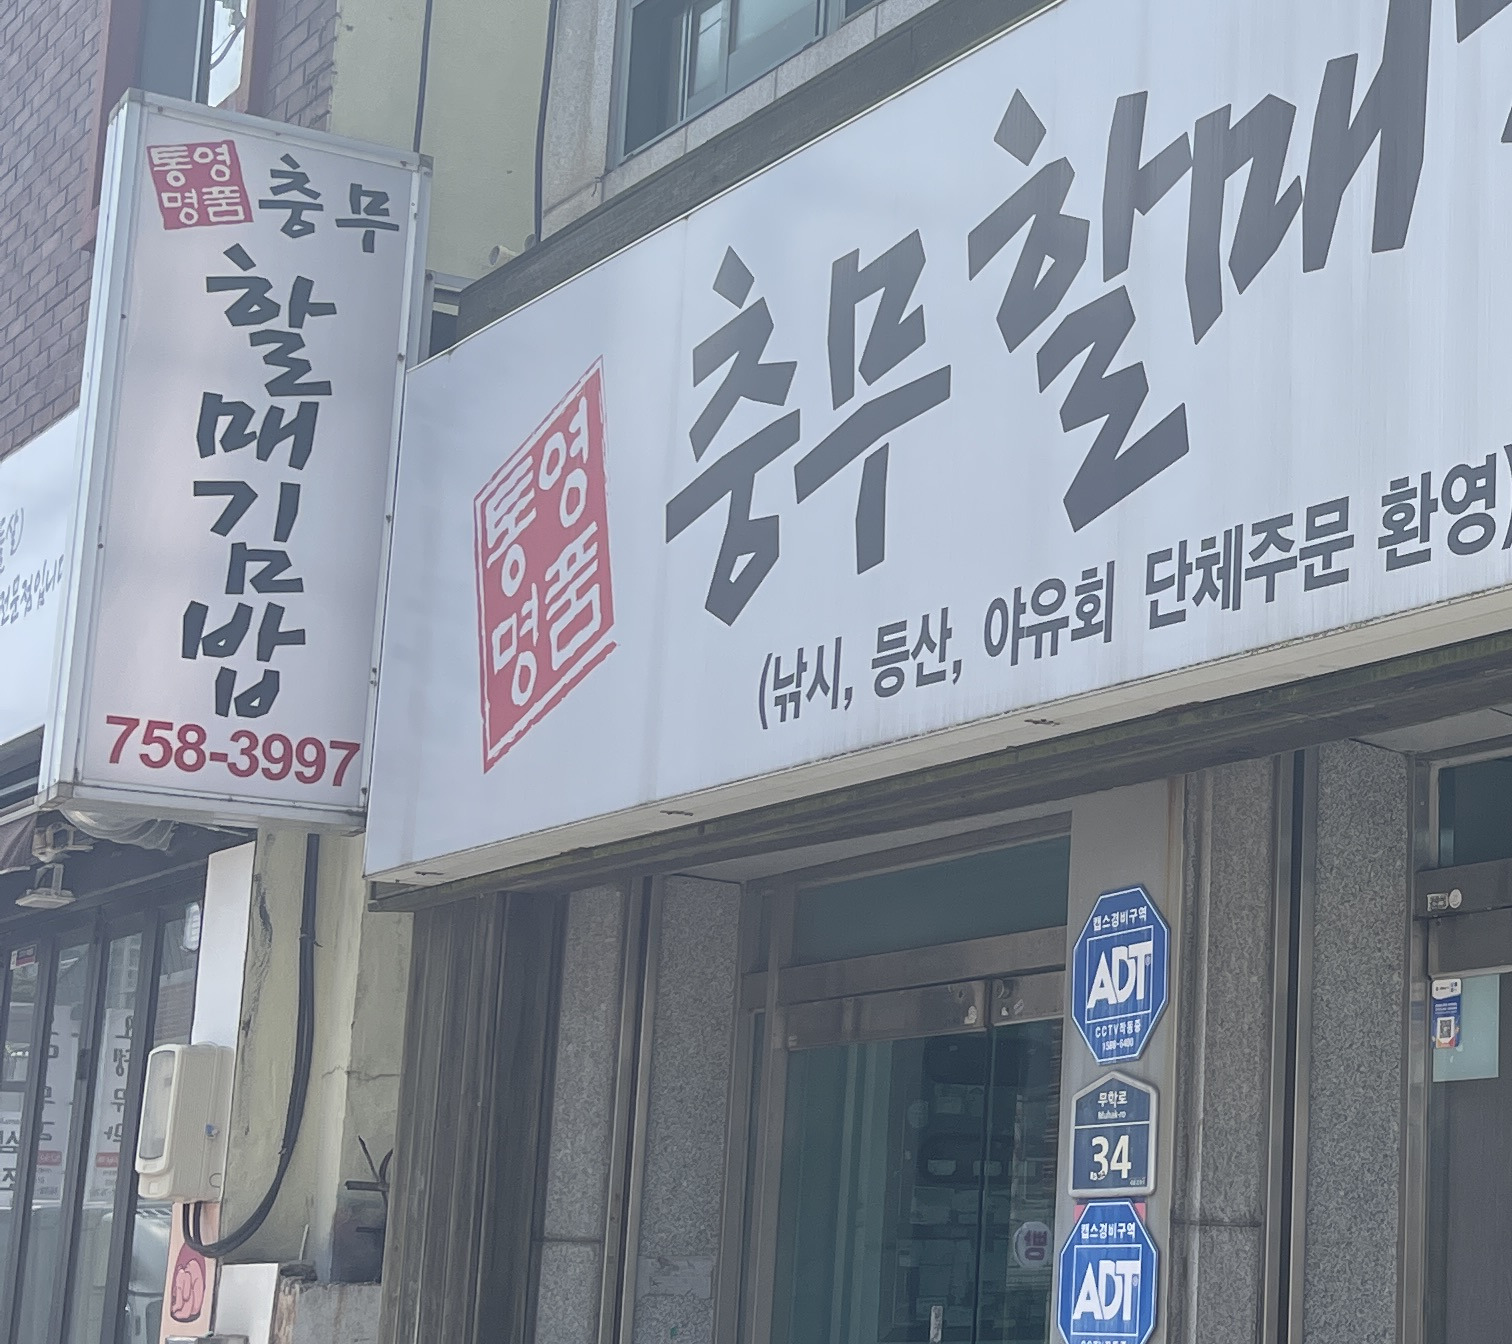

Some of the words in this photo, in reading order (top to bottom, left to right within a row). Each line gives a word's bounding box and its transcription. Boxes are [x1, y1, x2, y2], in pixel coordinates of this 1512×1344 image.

[149, 142, 232, 185] 통영
[161, 184, 247, 230] 명품
[257, 154, 400, 253] 충무
[181, 244, 337, 719] 할매김밥
[485, 396, 591, 597] 통영
[491, 524, 601, 707] 명품
[758, 634, 853, 730] (낚시,
[871, 606, 962, 697] 등산,
[983, 561, 1115, 666] 야유회
[1146, 495, 1354, 630] 단체주문
[105, 714, 361, 788] 758-3997
[1093, 906, 1147, 931] 캡스경비구역
[1087, 941, 1153, 1009] ADT
[1098, 1091, 1128, 1108] 무학로
[1090, 1134, 1132, 1180] 34
[1081, 1222, 1135, 1239] 캡스경비구역
[1072, 1260, 1141, 1320] ADT
